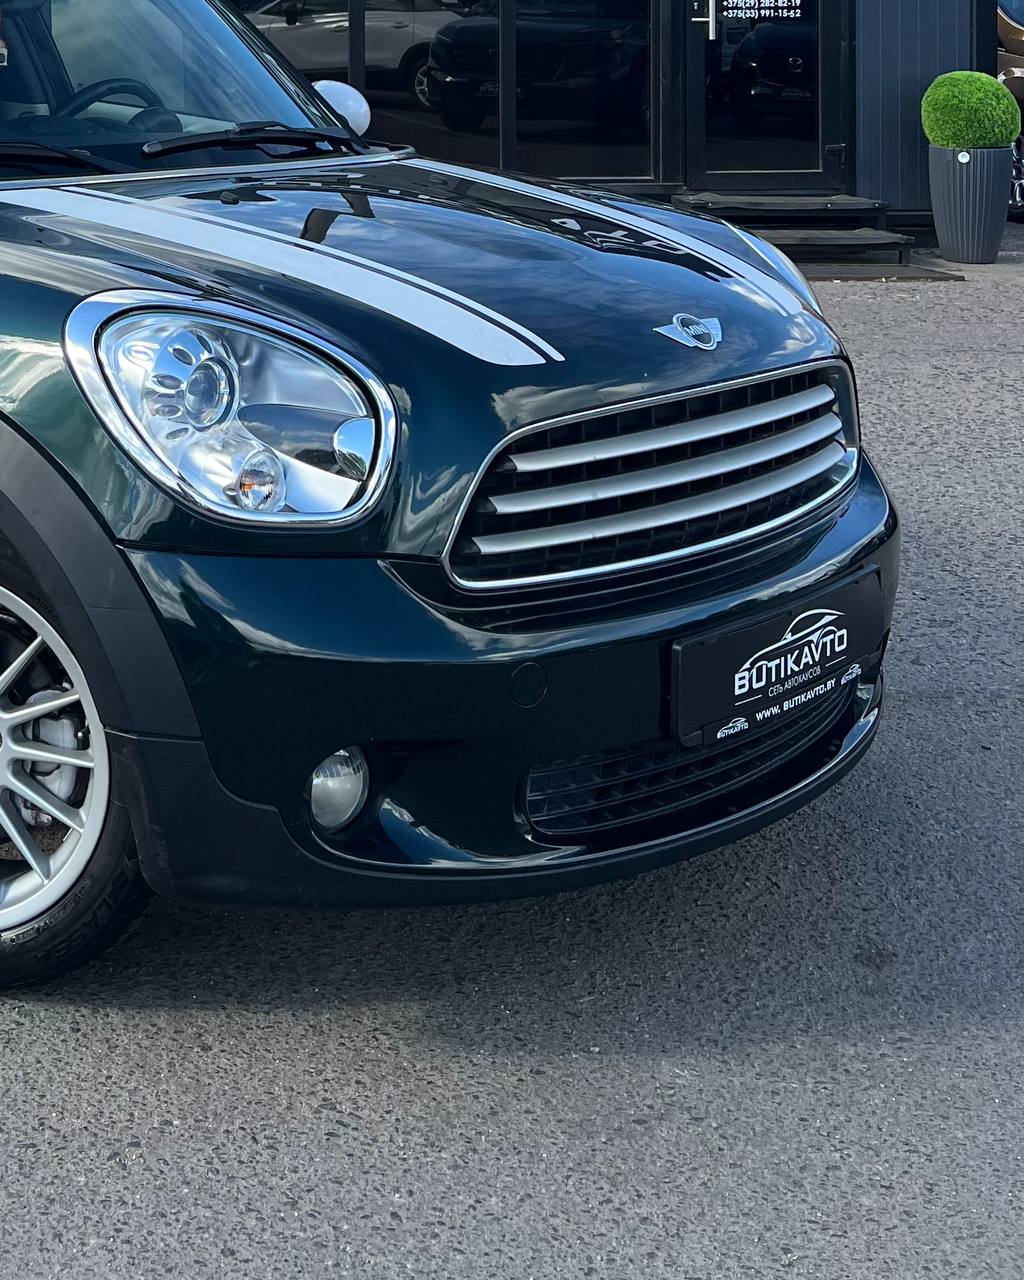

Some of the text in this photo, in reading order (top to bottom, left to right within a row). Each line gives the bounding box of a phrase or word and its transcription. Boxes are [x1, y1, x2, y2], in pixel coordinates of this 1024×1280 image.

[722, 0, 801, 9] +375(29) 282-82-19
[722, 9, 801, 19] +375(33) 991-15-52
[734, 628, 848, 696] BUTIKAVTO
[768, 666, 821, 697] СЕТЬ АВТОХАУСОВ
[756, 677, 836, 722] WWW. BUTIKAVTO.BY
